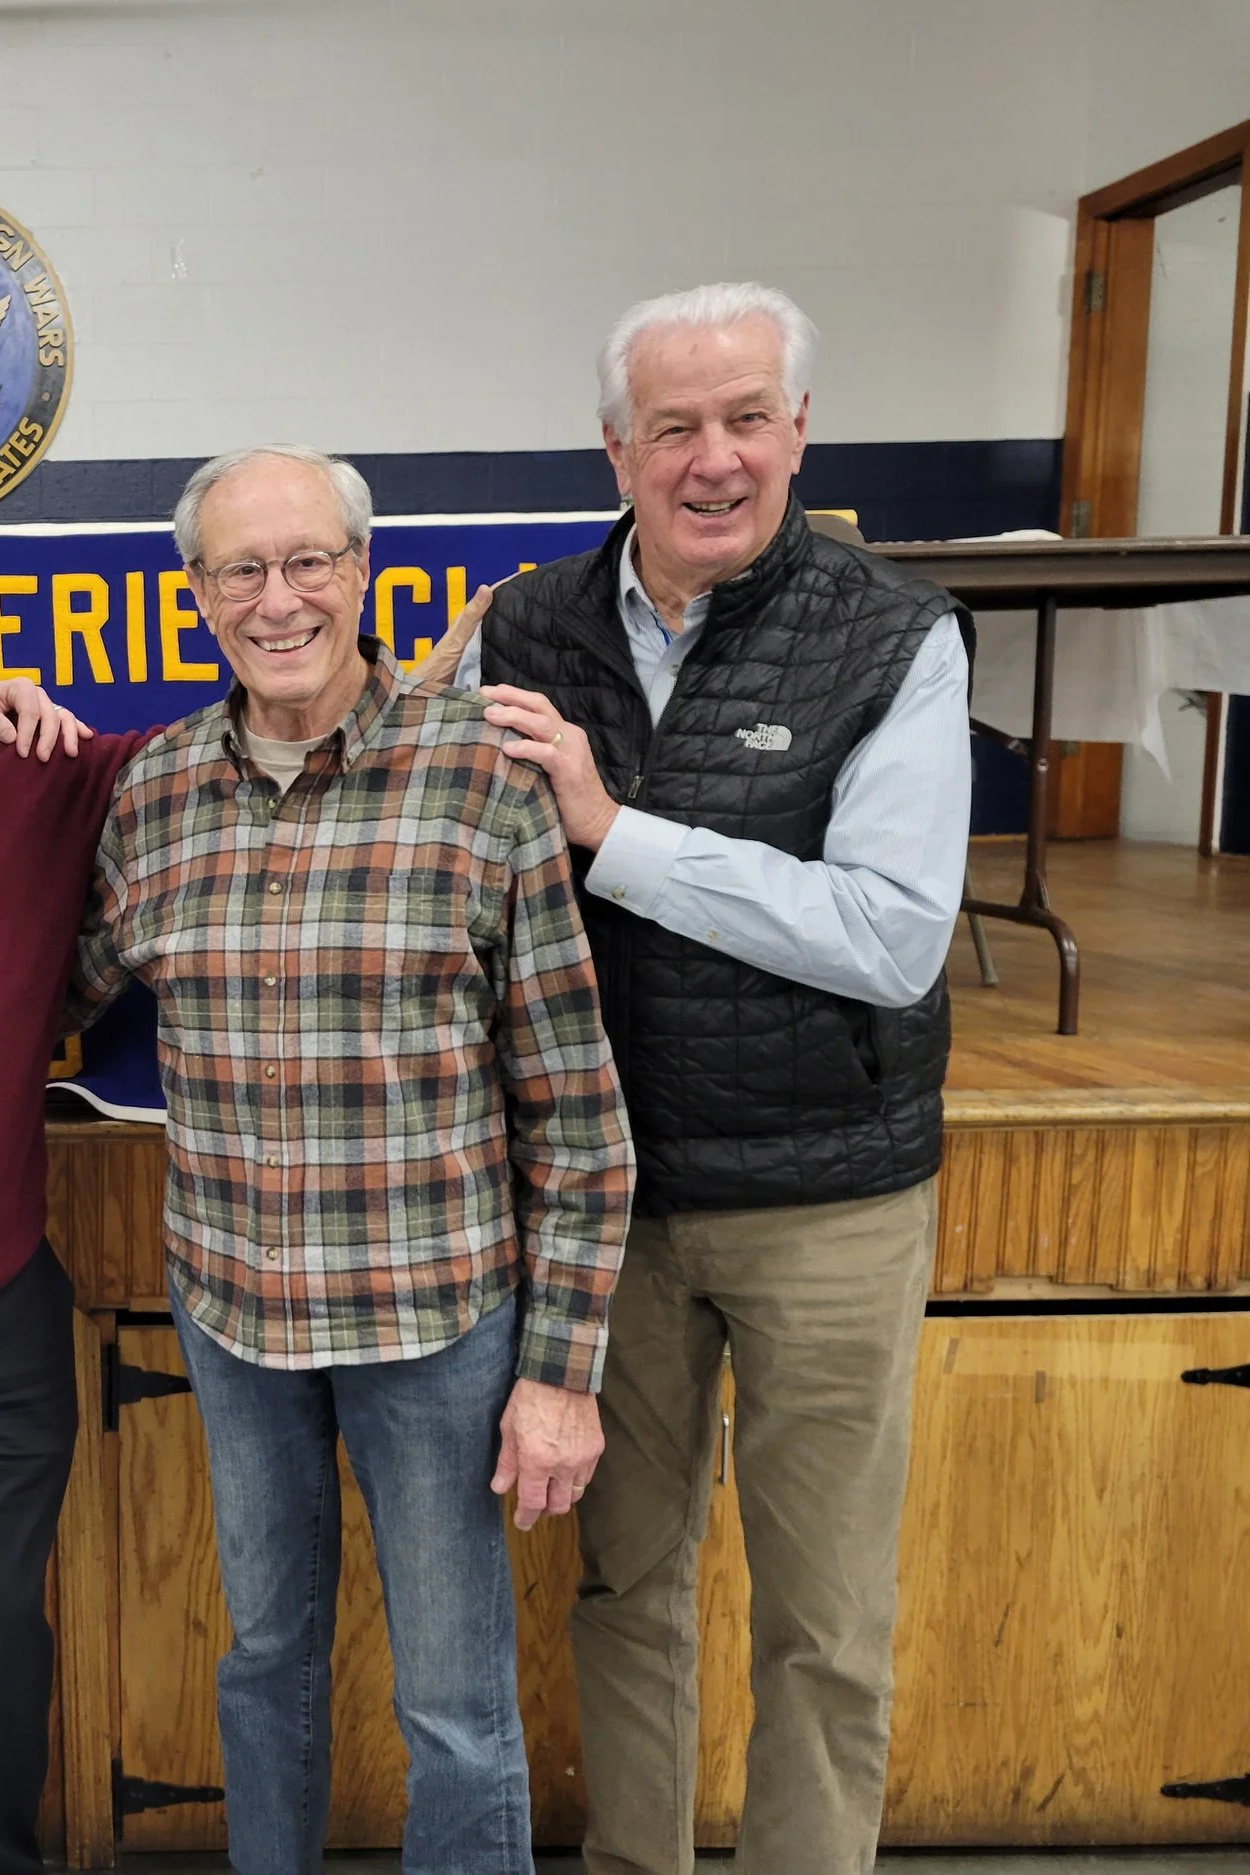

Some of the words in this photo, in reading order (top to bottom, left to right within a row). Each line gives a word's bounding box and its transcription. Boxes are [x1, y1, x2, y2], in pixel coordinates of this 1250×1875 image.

[24, 273, 64, 369] WARS
[735, 728, 773, 742] NORTH
[745, 739, 773, 751] FACE
